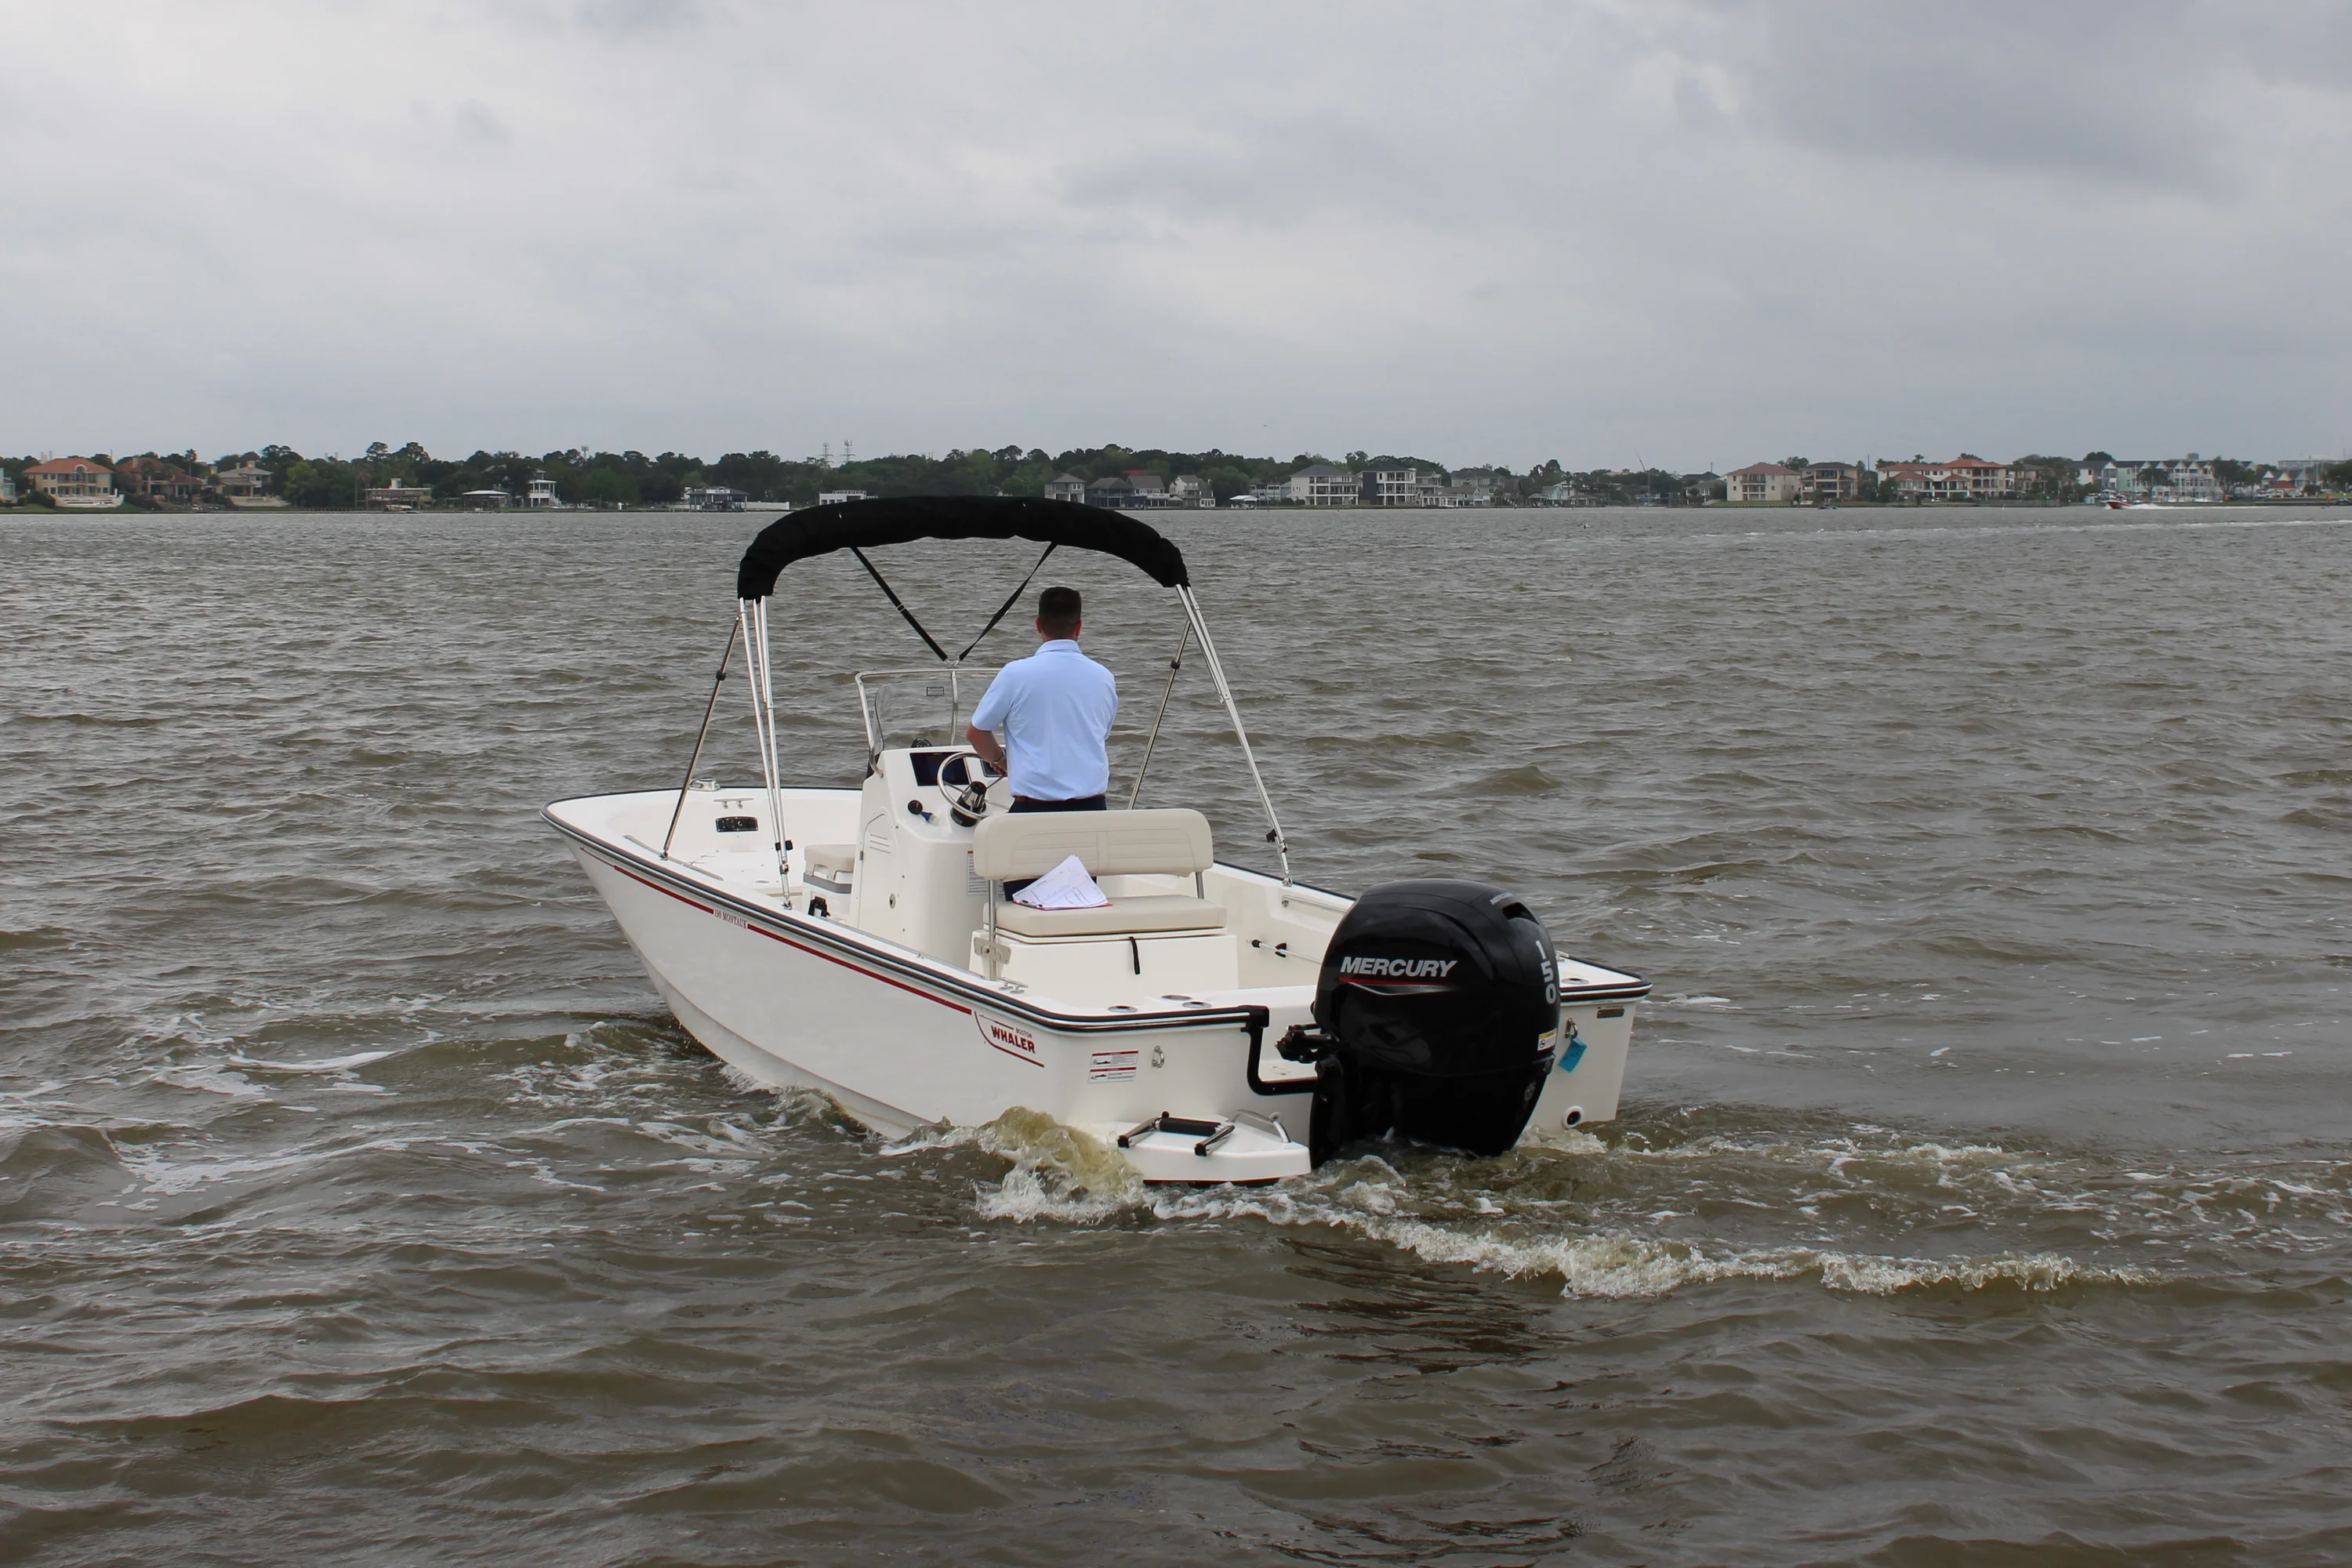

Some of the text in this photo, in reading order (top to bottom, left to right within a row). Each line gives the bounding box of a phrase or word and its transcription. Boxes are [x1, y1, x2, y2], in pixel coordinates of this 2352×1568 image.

[723, 911, 747, 929] MONTAUK
[1340, 956, 1457, 978] MERCURY
[1535, 940, 1556, 1004] 150
[990, 1025, 1036, 1054] WHALER
